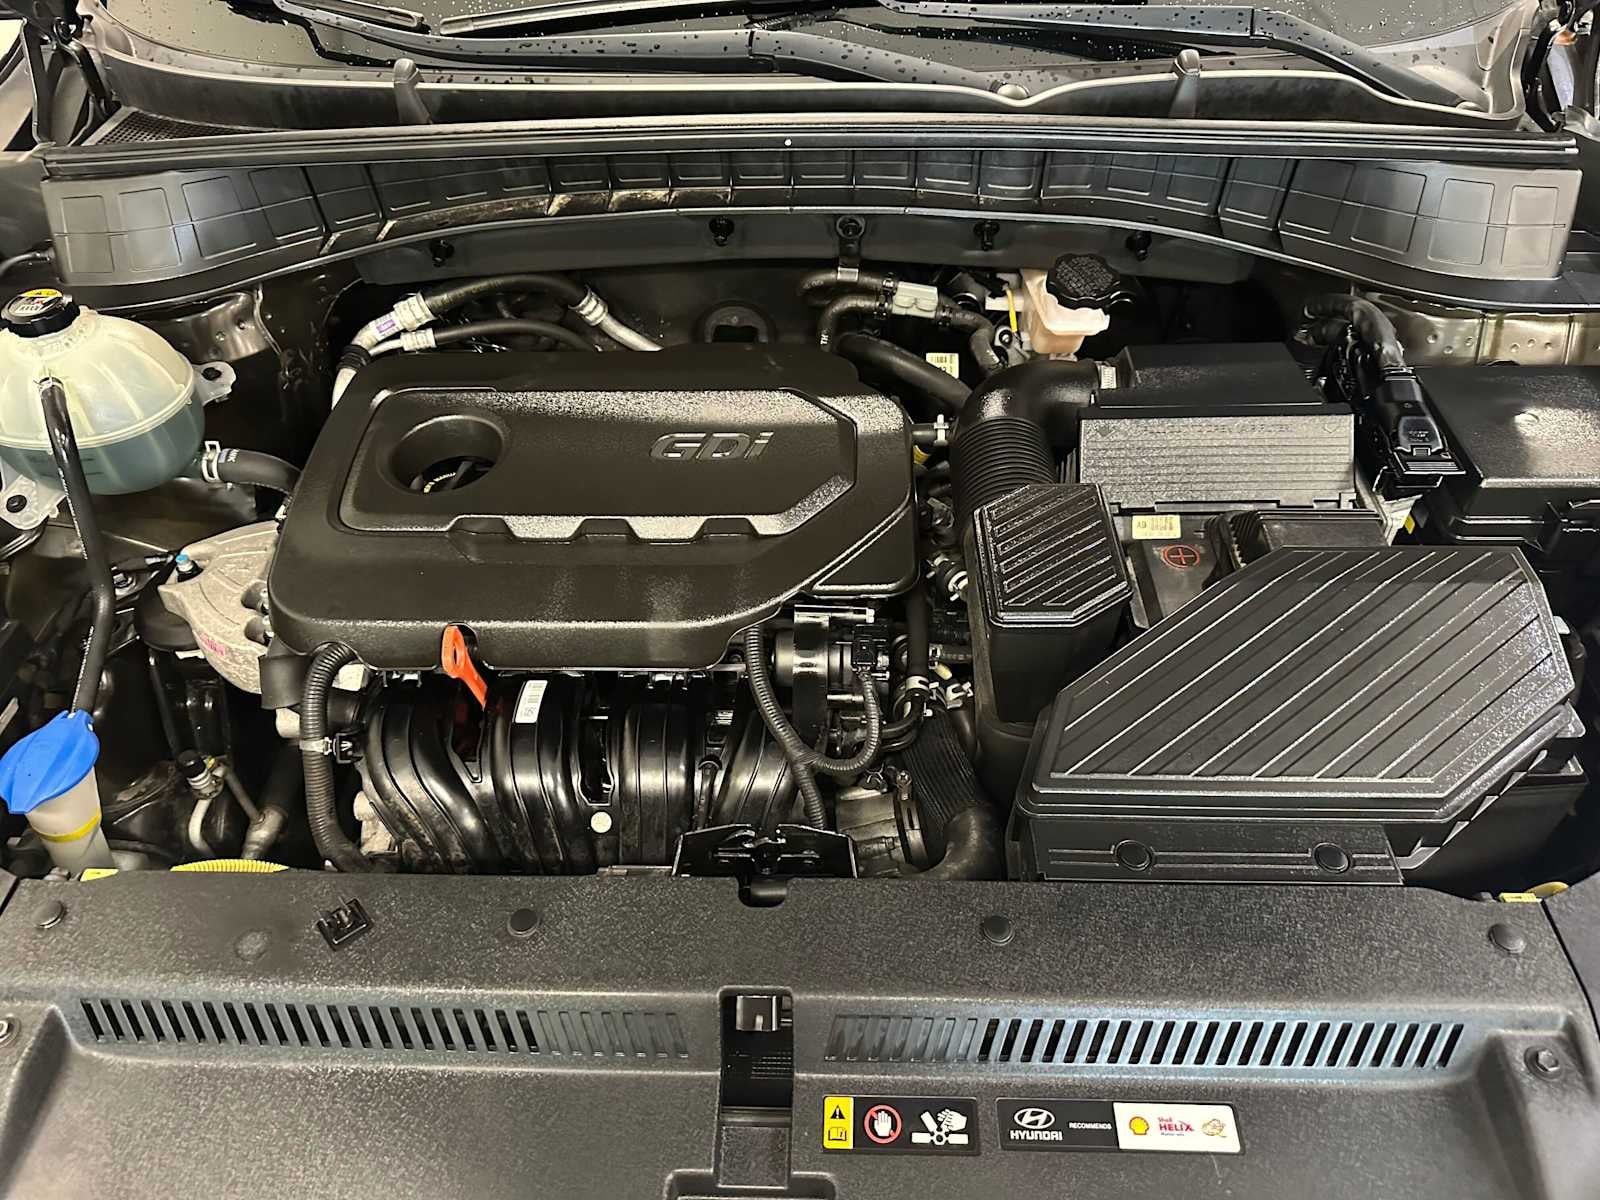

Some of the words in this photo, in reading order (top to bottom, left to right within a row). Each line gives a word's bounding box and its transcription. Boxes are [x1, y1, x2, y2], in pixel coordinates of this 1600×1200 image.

[649, 432, 774, 460] GDi
[1158, 1121, 1194, 1132] HELIX
[1010, 1130, 1063, 1140] HYUNDAI
